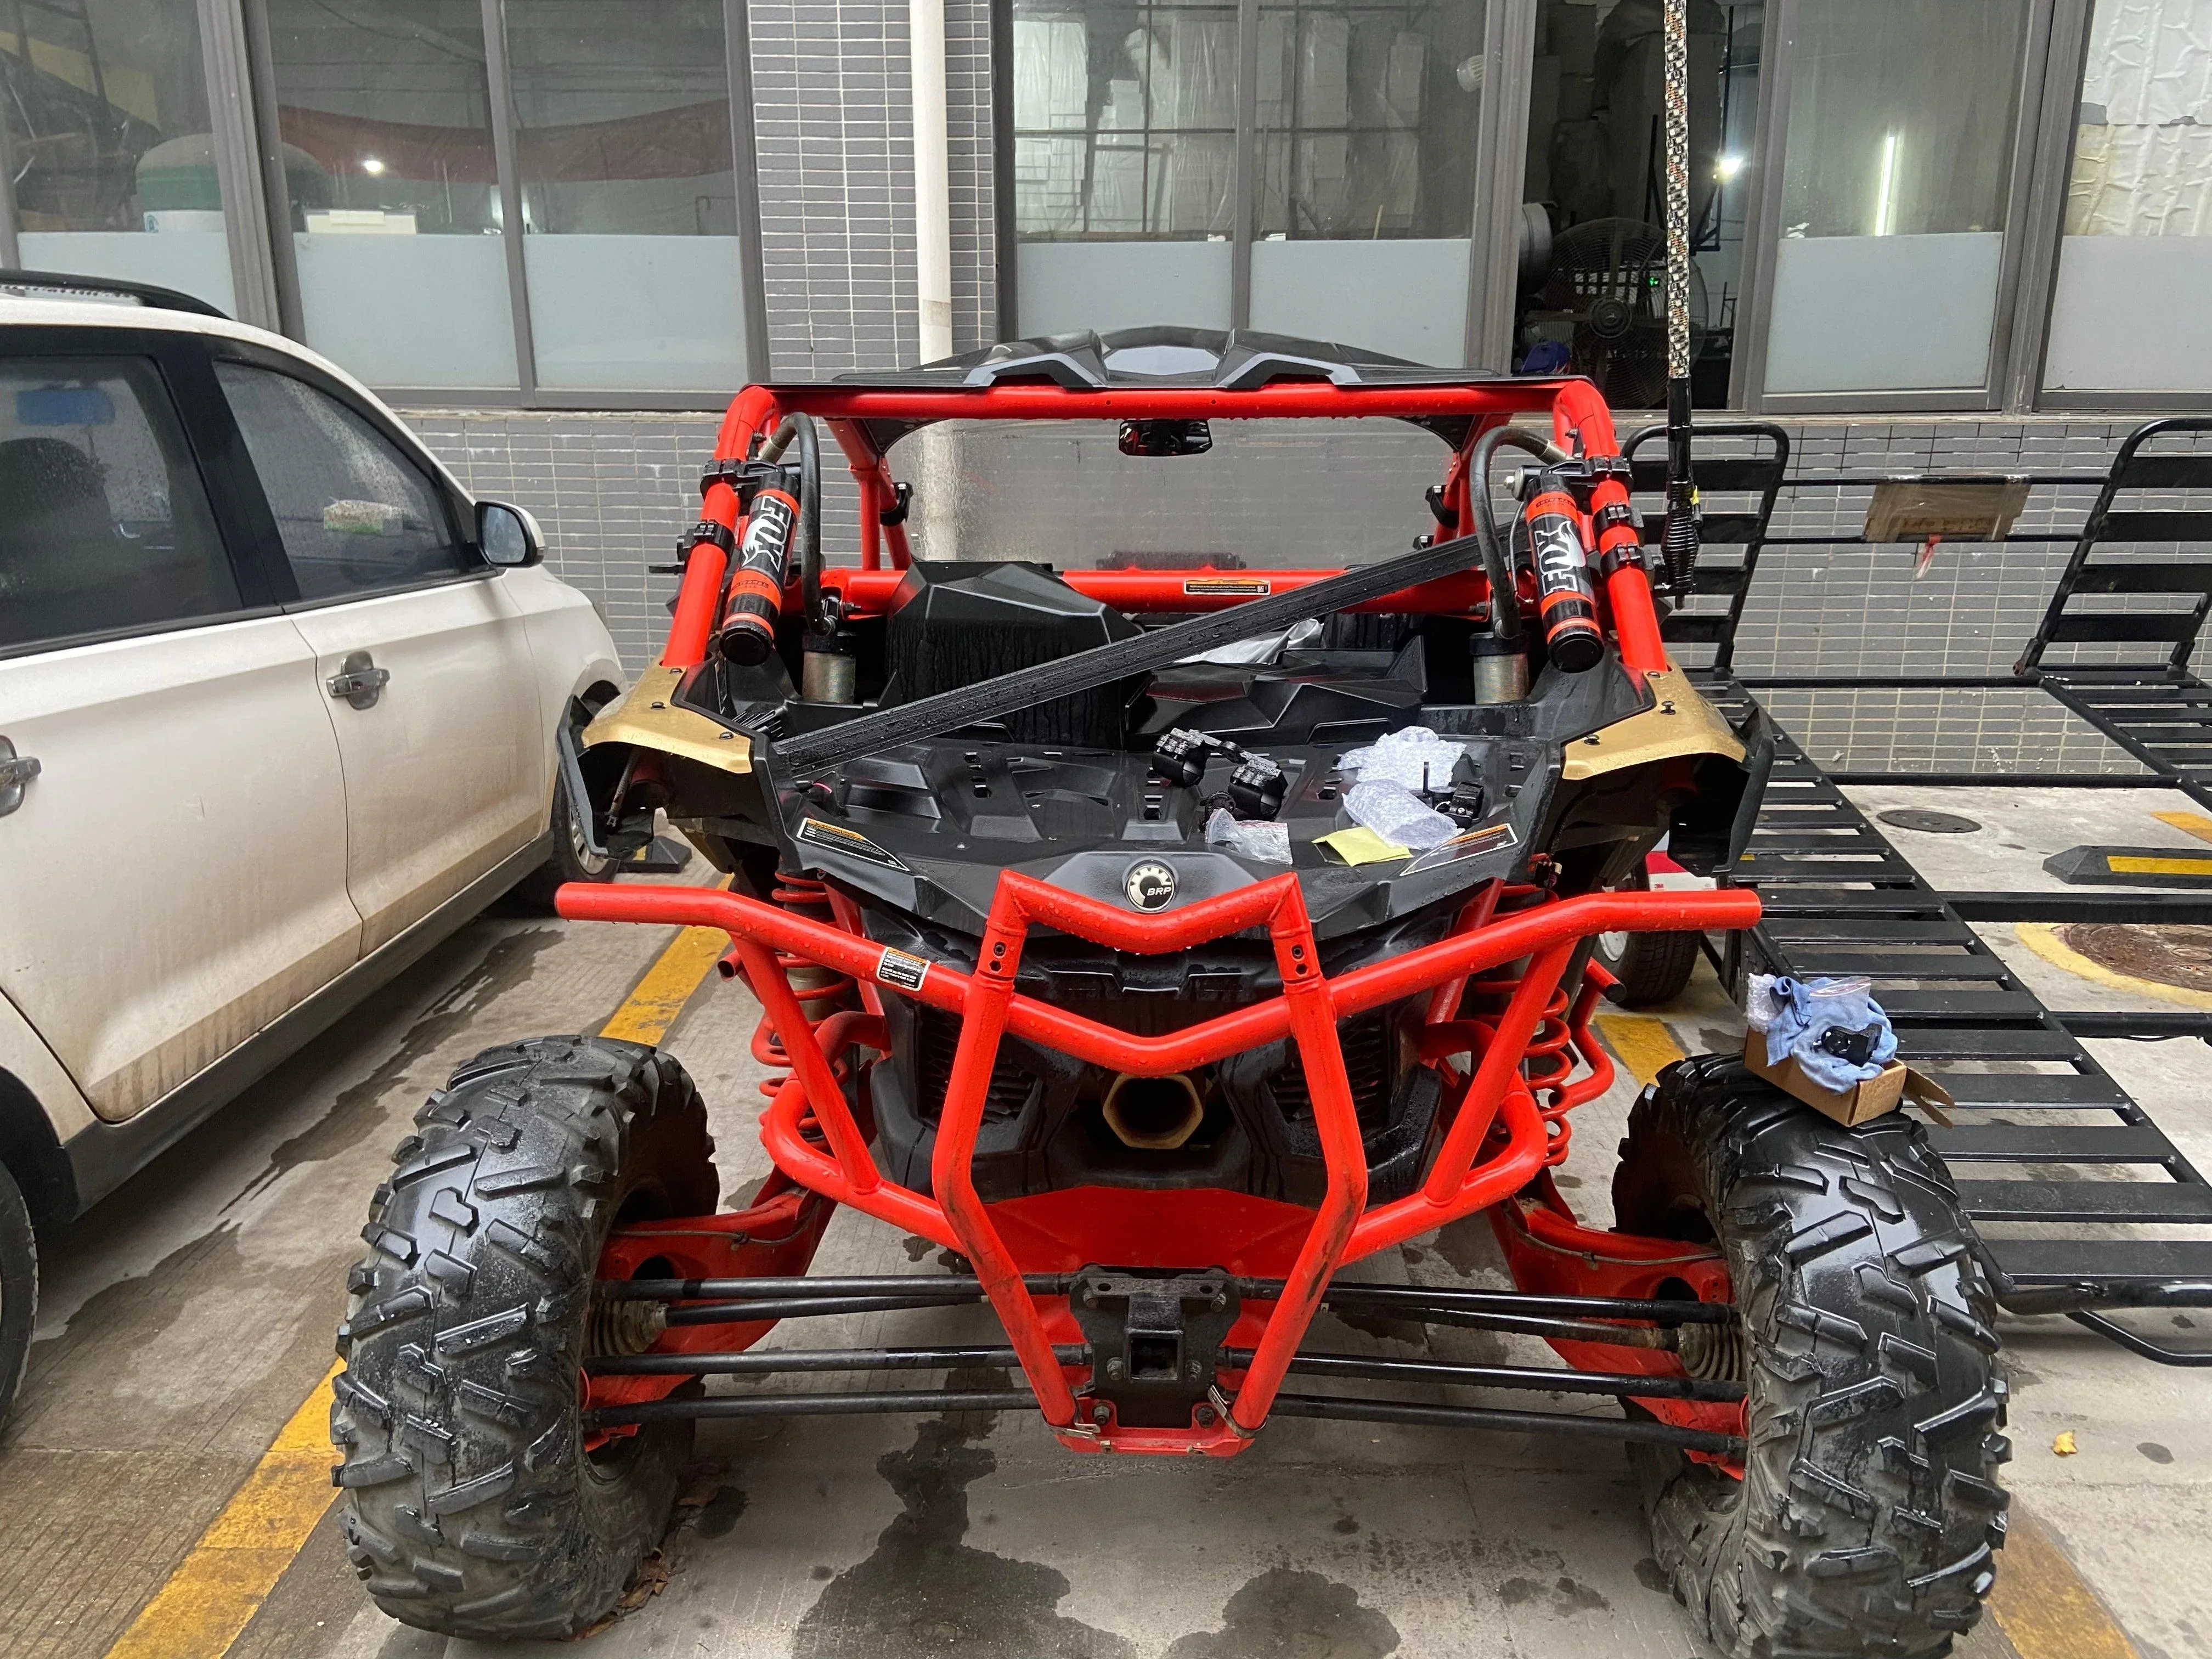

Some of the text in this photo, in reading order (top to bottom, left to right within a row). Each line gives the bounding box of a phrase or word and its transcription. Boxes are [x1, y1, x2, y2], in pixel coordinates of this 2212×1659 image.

[742, 496, 791, 572] FOX
[1534, 521, 1585, 596] FOX
[1147, 887, 1172, 896] BRP
